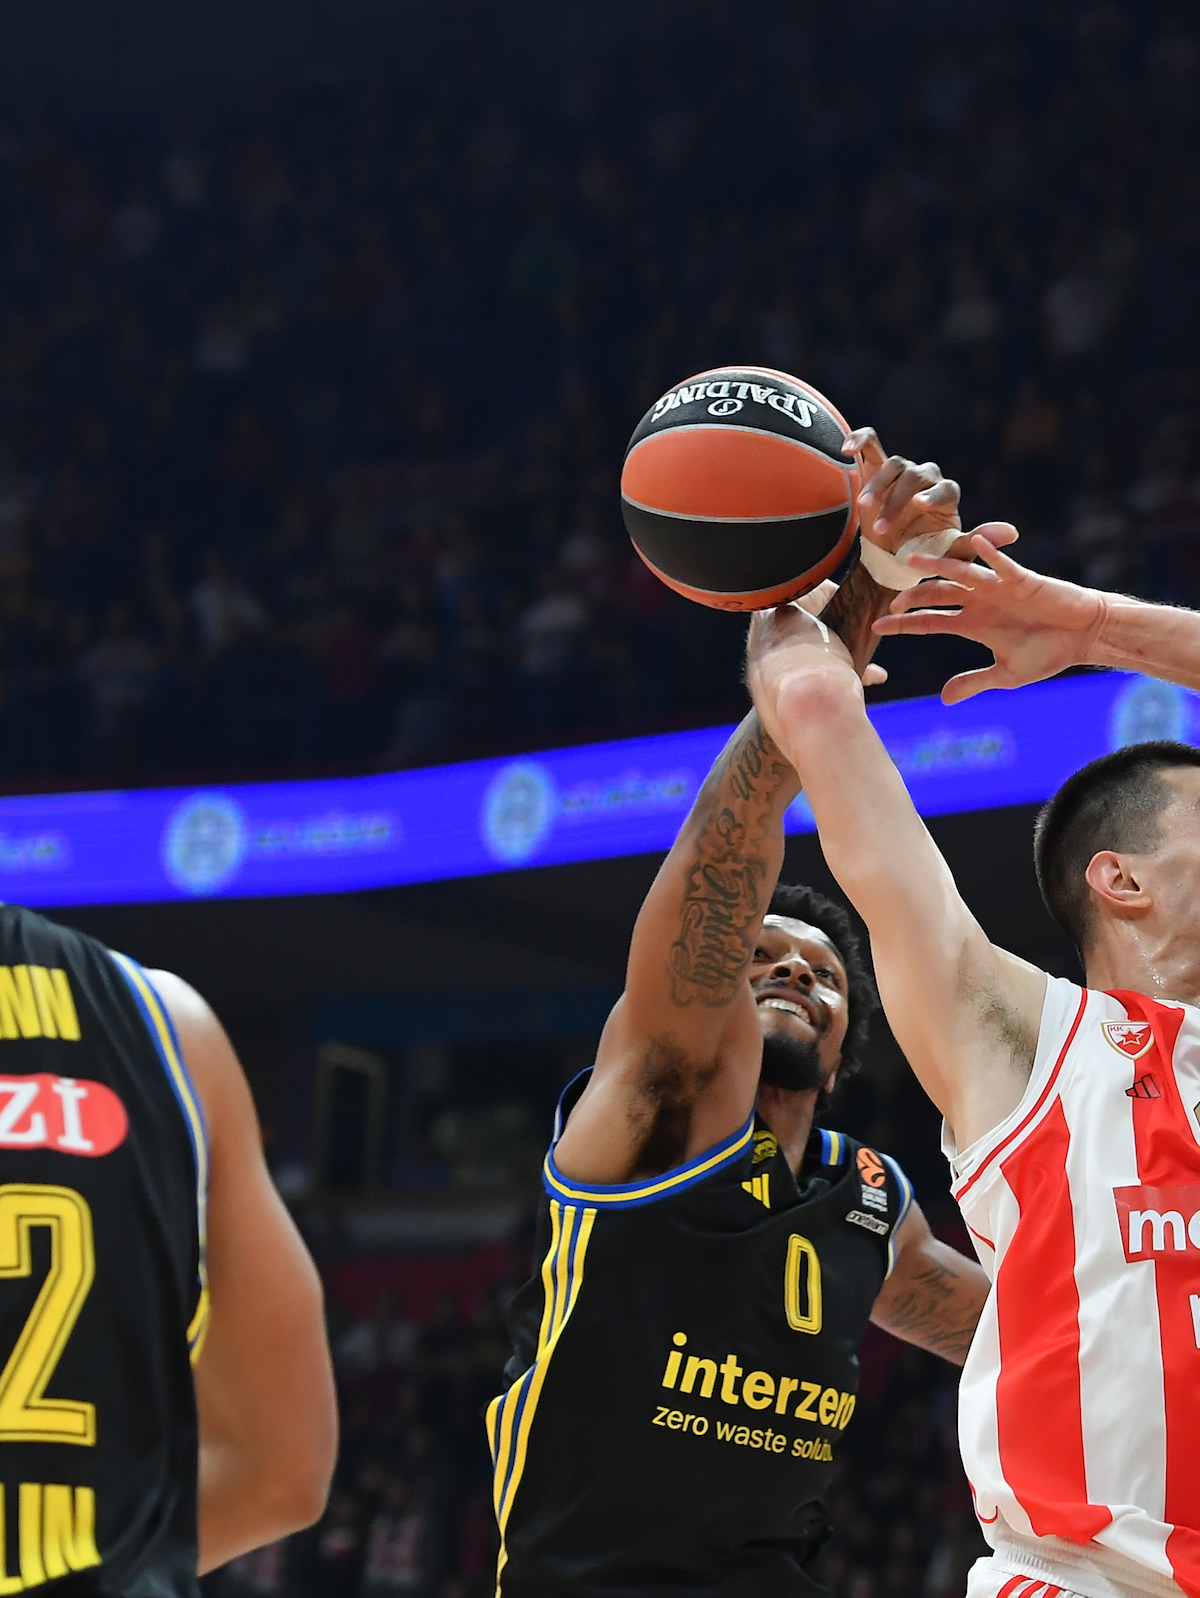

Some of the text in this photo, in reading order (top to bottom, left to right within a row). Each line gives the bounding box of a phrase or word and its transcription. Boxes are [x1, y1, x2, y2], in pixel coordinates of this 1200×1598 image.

[651, 381, 818, 428] SPALDING
[0, 1184, 97, 1447] 2
[784, 1233, 822, 1335] 0
[652, 1405, 709, 1436] zero
[716, 1421, 787, 1453] waste
